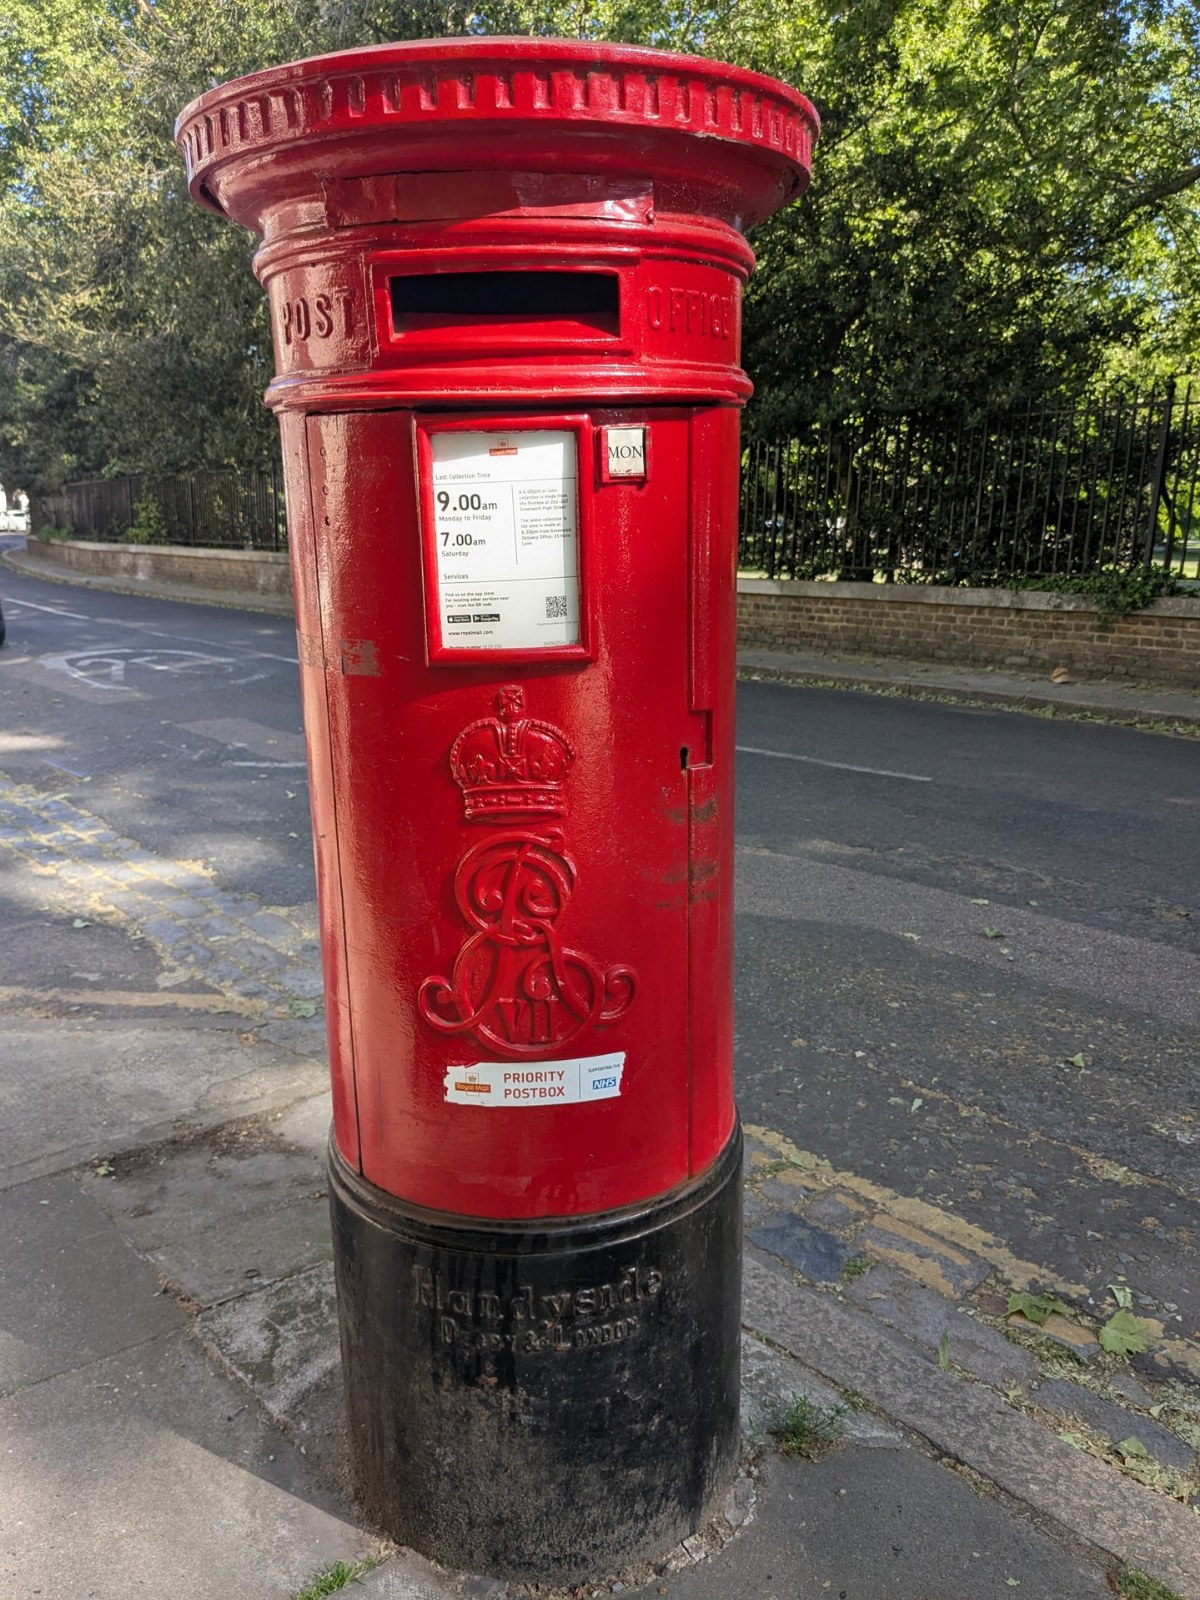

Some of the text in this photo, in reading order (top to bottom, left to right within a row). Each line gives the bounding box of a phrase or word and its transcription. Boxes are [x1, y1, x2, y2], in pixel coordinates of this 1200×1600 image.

[282, 286, 730, 345] POST OFFICE
[608, 446, 643, 458] MON
[437, 491, 498, 512] 9.00am
[440, 532, 486, 546] 7.00am
[504, 1070, 565, 1083] PRIORITY
[594, 1077, 615, 1089] NHS
[504, 1086, 565, 1098] POSTBOX
